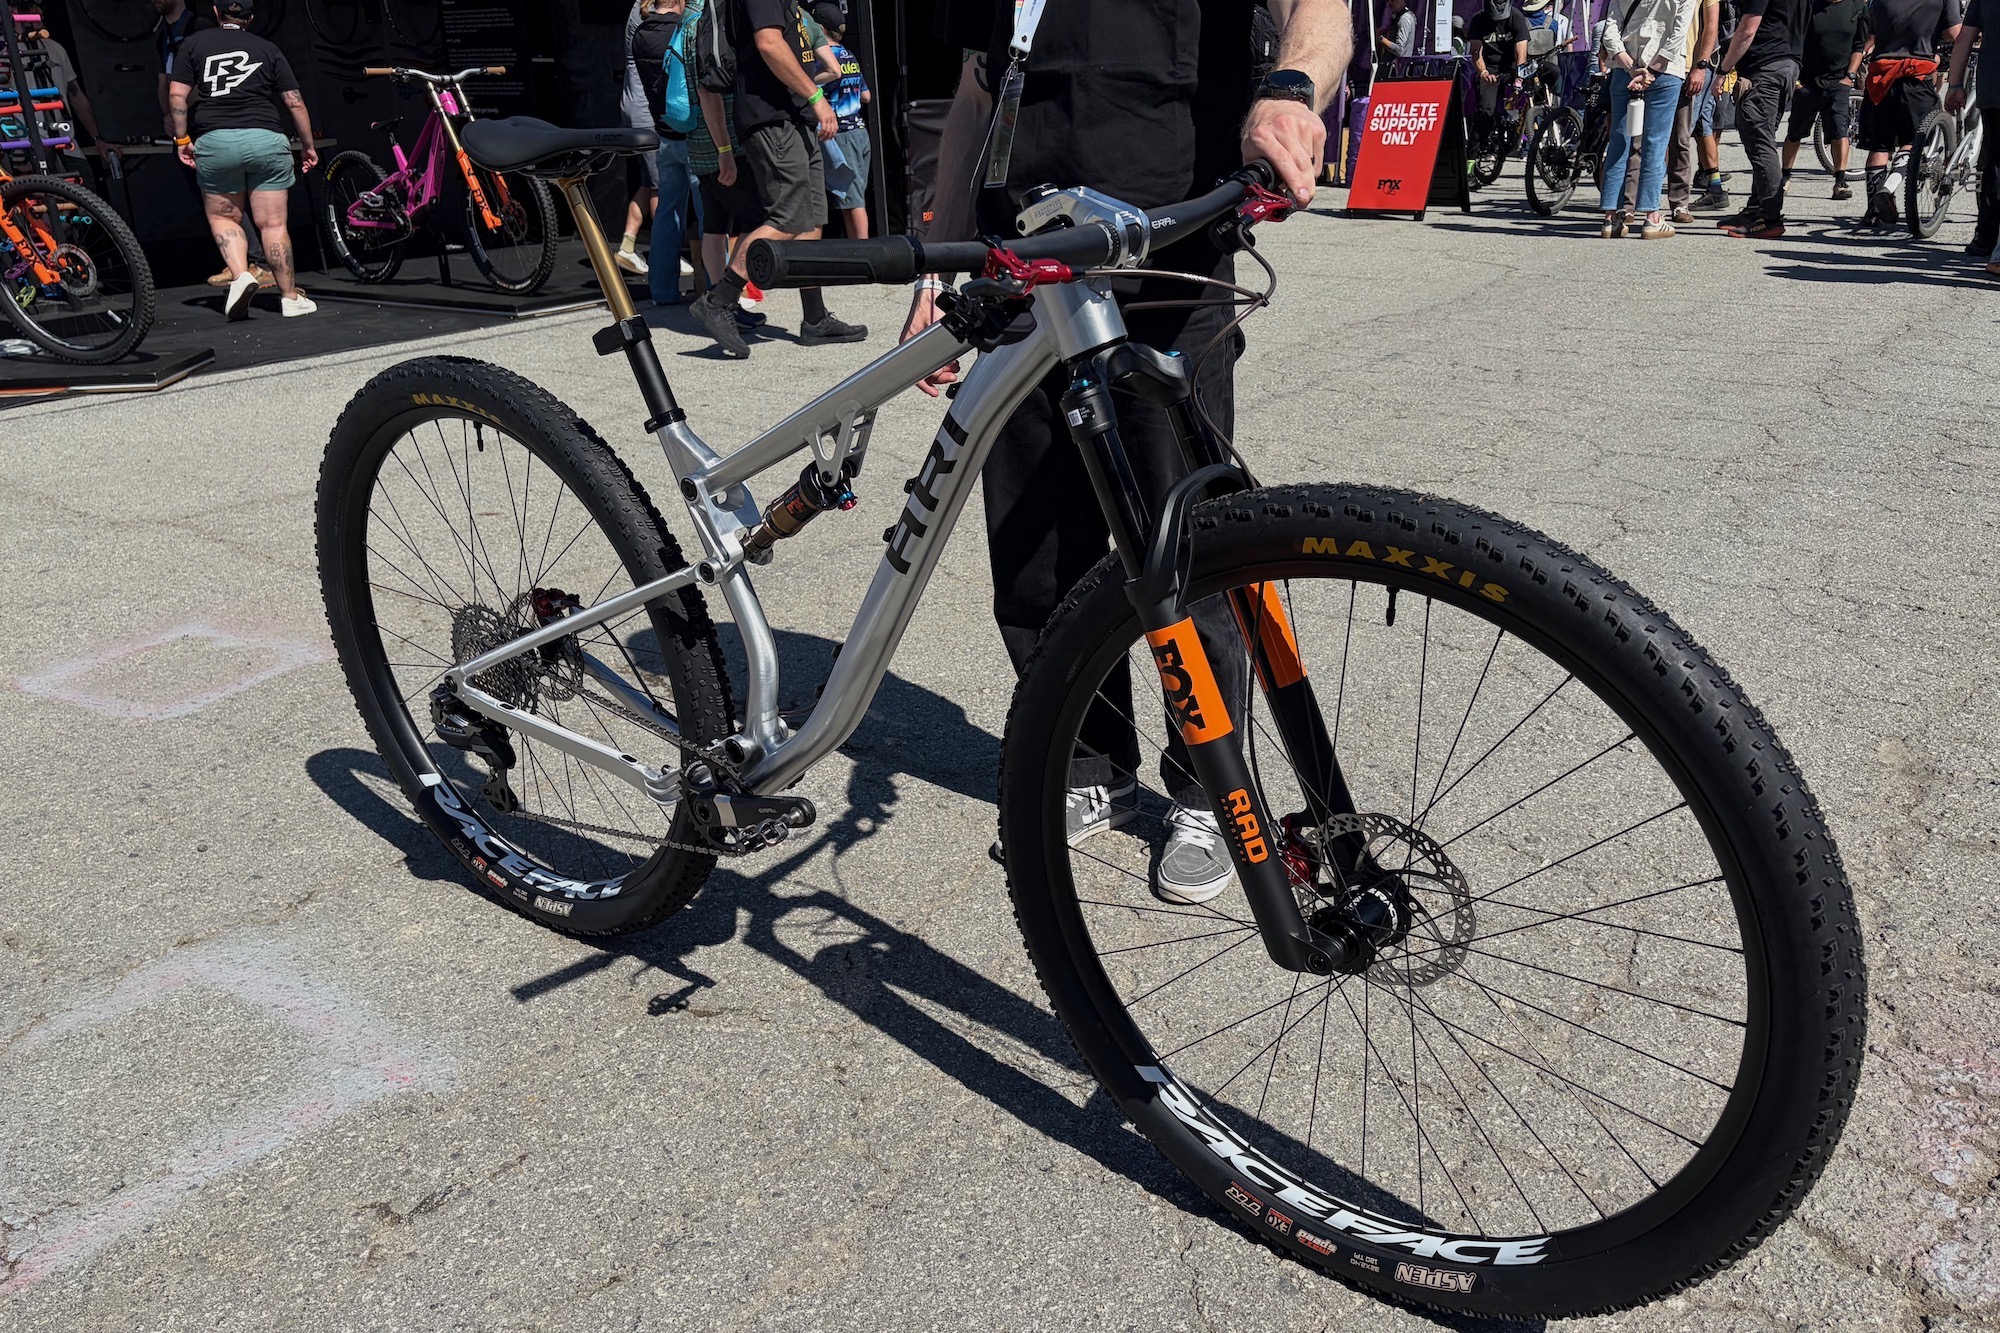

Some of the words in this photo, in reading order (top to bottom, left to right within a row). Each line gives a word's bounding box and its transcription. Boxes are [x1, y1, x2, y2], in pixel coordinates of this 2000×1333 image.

[1373, 102, 1440, 118] ATHLETE
[1369, 117, 1438, 132] SUPPORT
[1381, 131, 1419, 146] ONLY
[1376, 179, 1402, 193] FOX
[1151, 216, 1171, 230] ERA
[16, 238, 41, 269] FOX
[885, 410, 970, 576] ARI
[1301, 536, 1511, 603] MAXXIS
[1154, 637, 1207, 731] FOX
[1220, 797, 1248, 863] PROTOTYPE
[1227, 787, 1269, 864] RAD
[533, 895, 575, 917] ASPEN
[1224, 1186, 1262, 1218] TR
[1265, 1215, 1289, 1234] EXO
[1296, 1228, 1338, 1254] speed
[1352, 1251, 1366, 1263] TPI
[1364, 1255, 1379, 1266] 120
[1394, 1261, 1478, 1294] ASPEN
